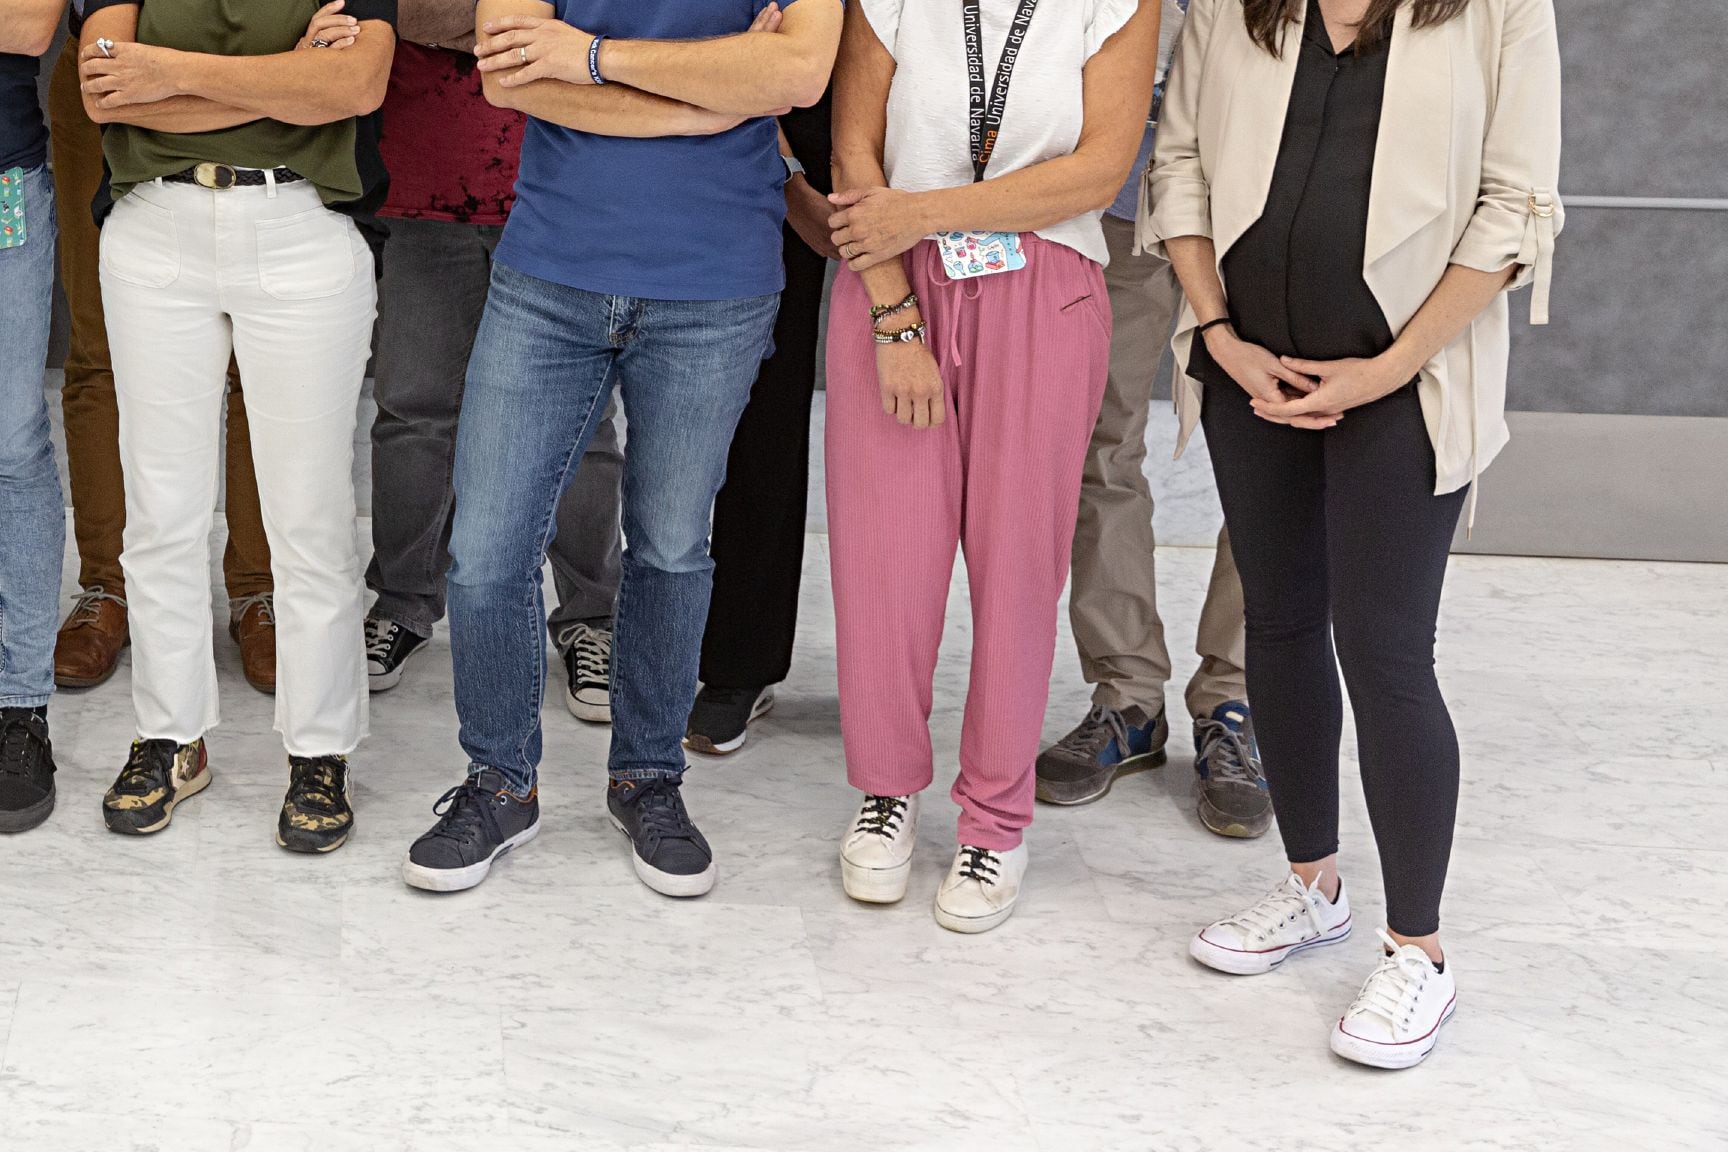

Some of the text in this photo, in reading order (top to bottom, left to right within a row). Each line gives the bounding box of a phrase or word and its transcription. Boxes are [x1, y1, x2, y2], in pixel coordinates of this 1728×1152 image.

[964, 5, 983, 82] Universidad
[1009, 28, 1025, 44] de
[970, 87, 984, 103] de
[986, 47, 1018, 125] Universidad
[979, 130, 997, 163] Cima
